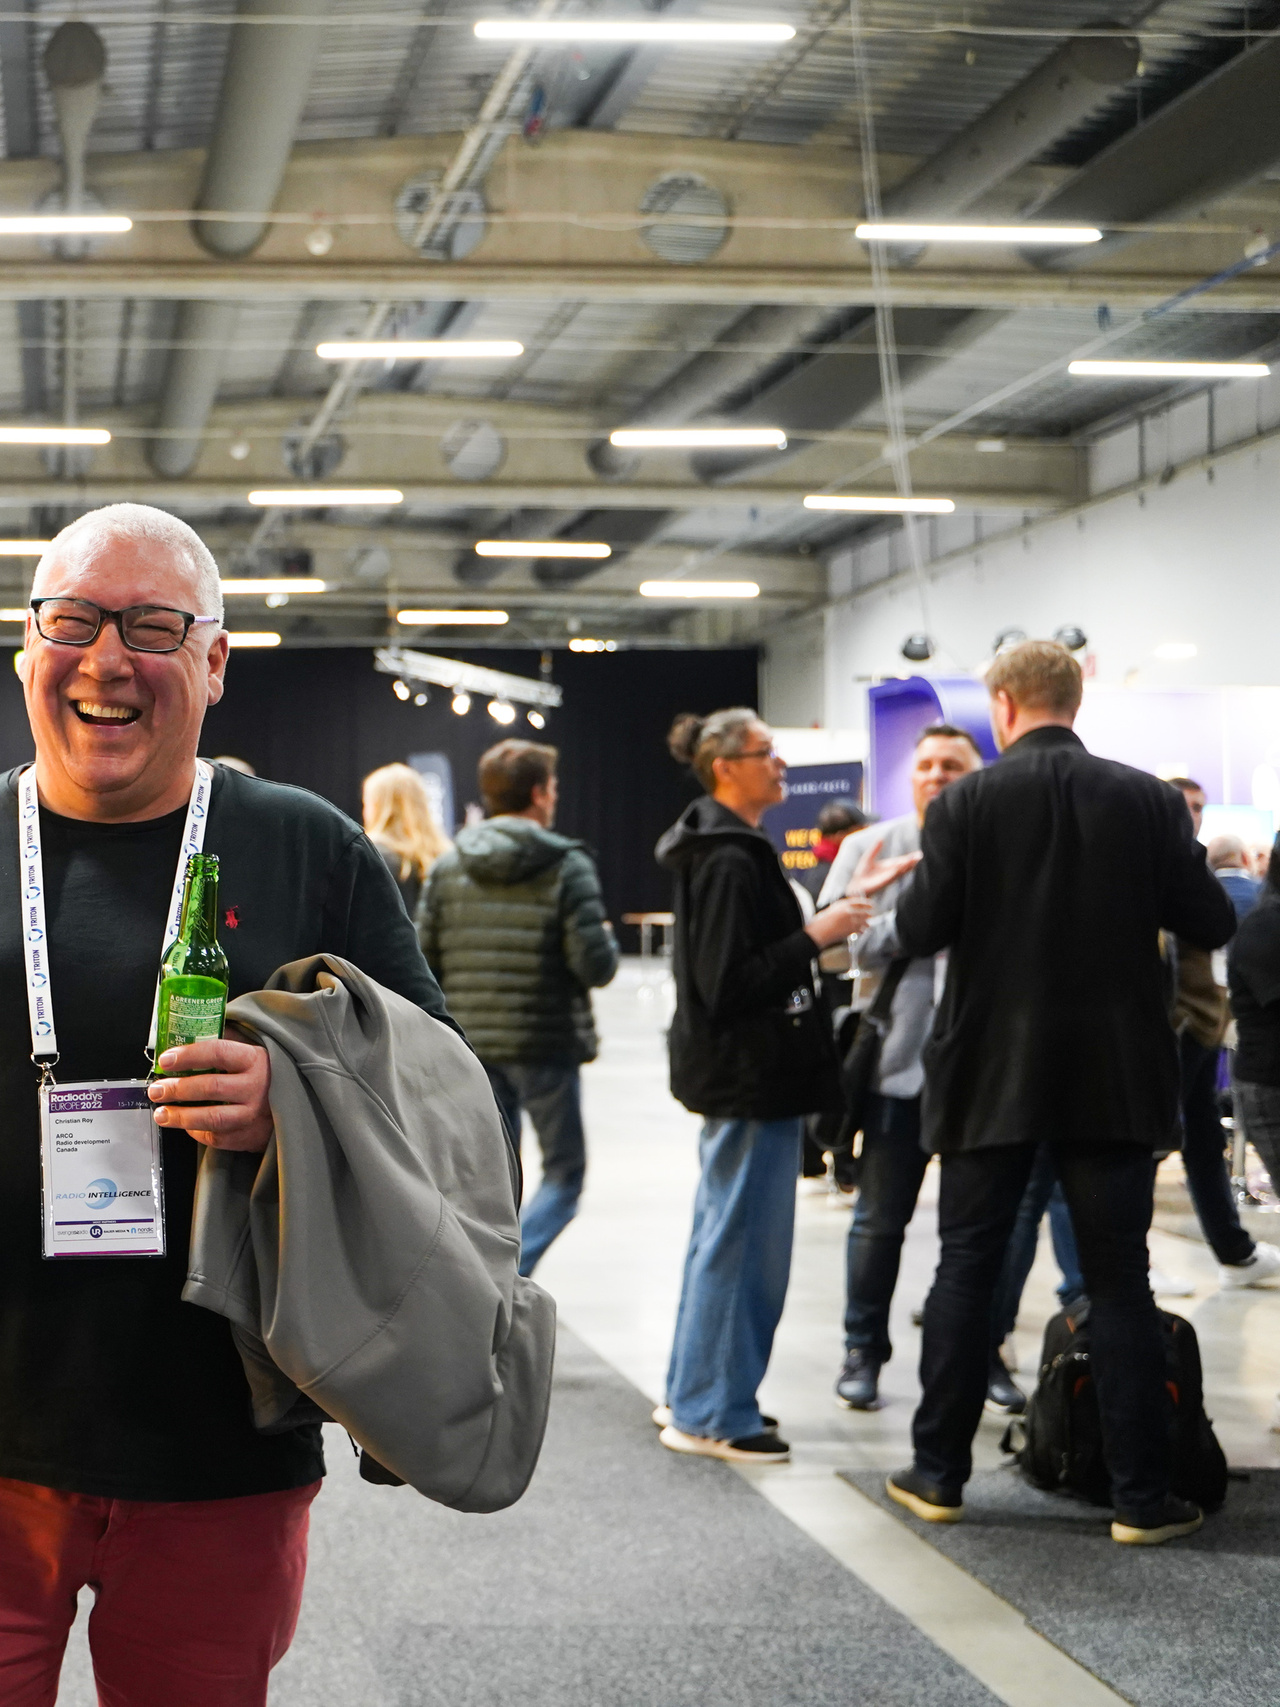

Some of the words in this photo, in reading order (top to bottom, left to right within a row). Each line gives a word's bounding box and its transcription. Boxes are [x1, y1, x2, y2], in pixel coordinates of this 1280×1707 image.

[196, 785, 205, 804] TRITON
[189, 823, 199, 842] TRITON
[29, 906, 37, 927] TRITON
[32, 949, 41, 971] TRITON
[36, 996, 45, 1020] TRITON
[176, 996, 205, 1004] GREENER
[50, 1101, 80, 1111] EUROPE
[80, 1101, 103, 1109] 2022
